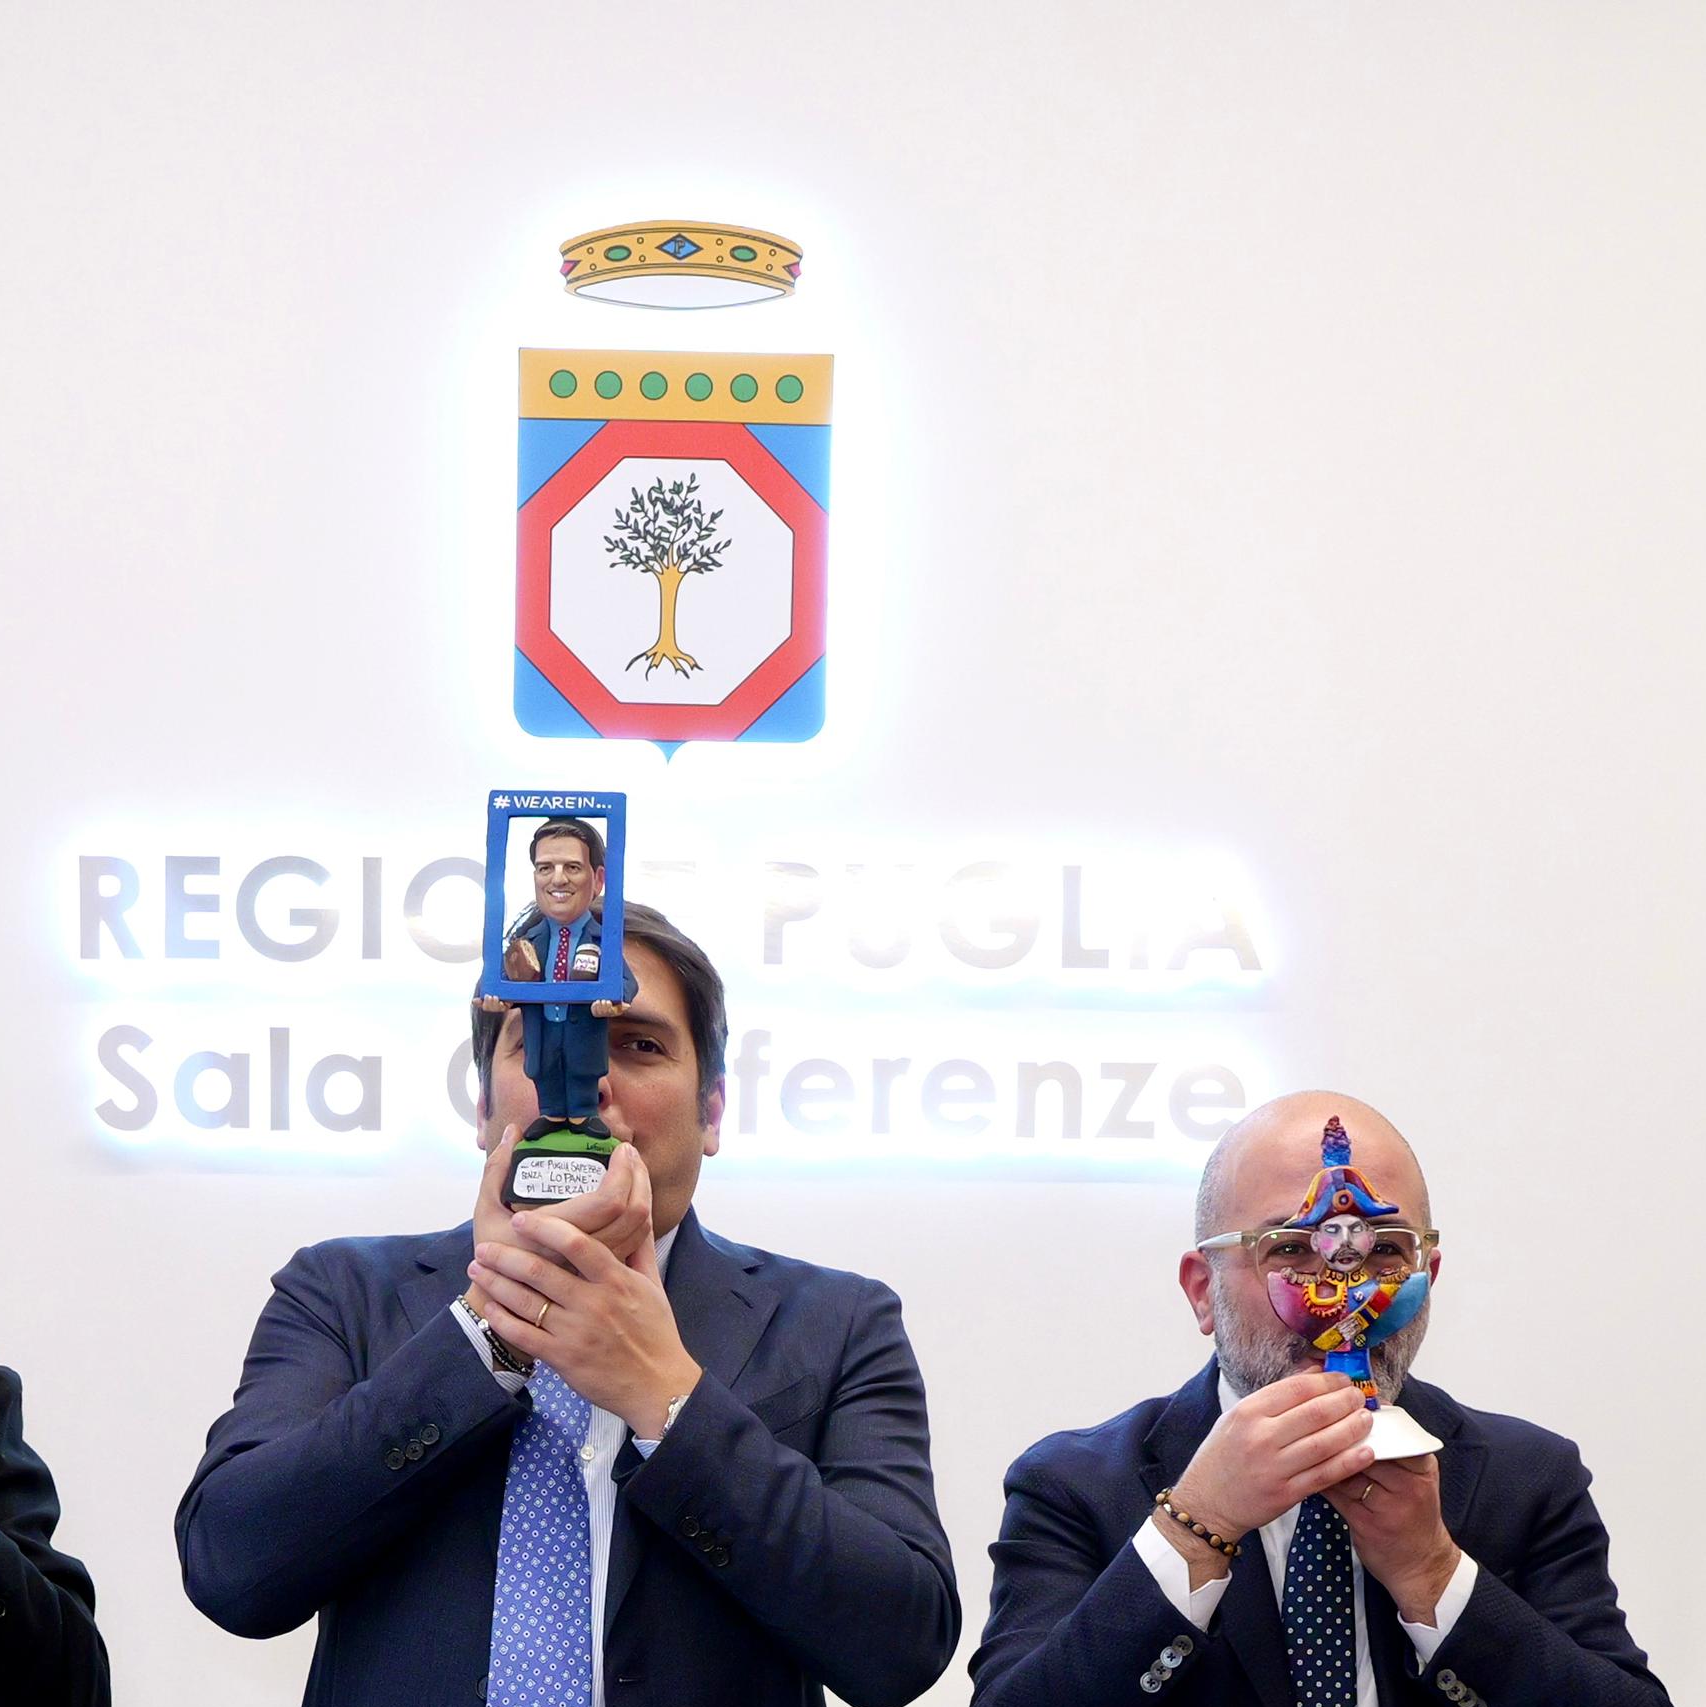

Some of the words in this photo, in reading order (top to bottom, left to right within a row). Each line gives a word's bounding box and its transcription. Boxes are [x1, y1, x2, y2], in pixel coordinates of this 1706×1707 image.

[760, 859, 1264, 973] PUGLIA
[92, 1023, 385, 1134] Sala
[445, 1025, 1246, 1142] ferenze
